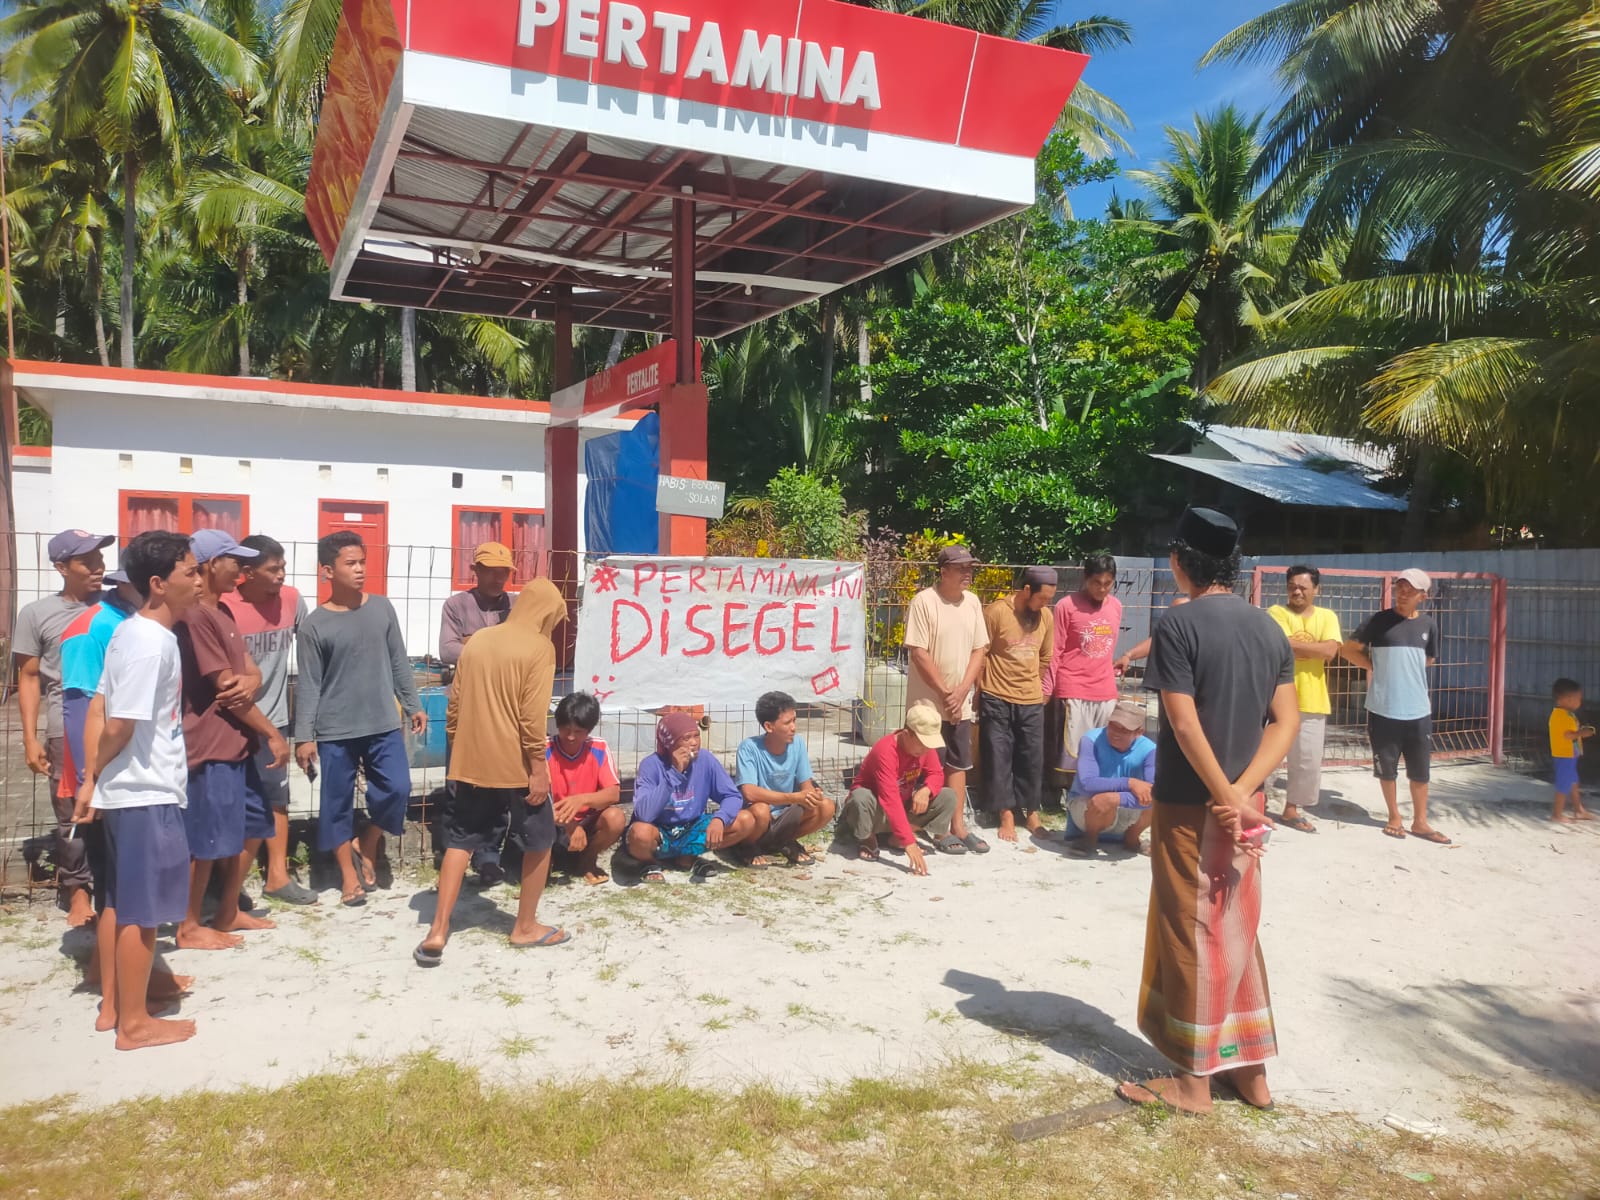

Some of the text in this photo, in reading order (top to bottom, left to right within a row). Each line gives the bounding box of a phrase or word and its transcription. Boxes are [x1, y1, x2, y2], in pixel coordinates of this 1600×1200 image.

[517, 0, 882, 110] PERTAMINA
[626, 362, 659, 396] PERTALITE
[688, 492, 718, 505] SOLAR
[610, 596, 851, 665] DISEGEL
